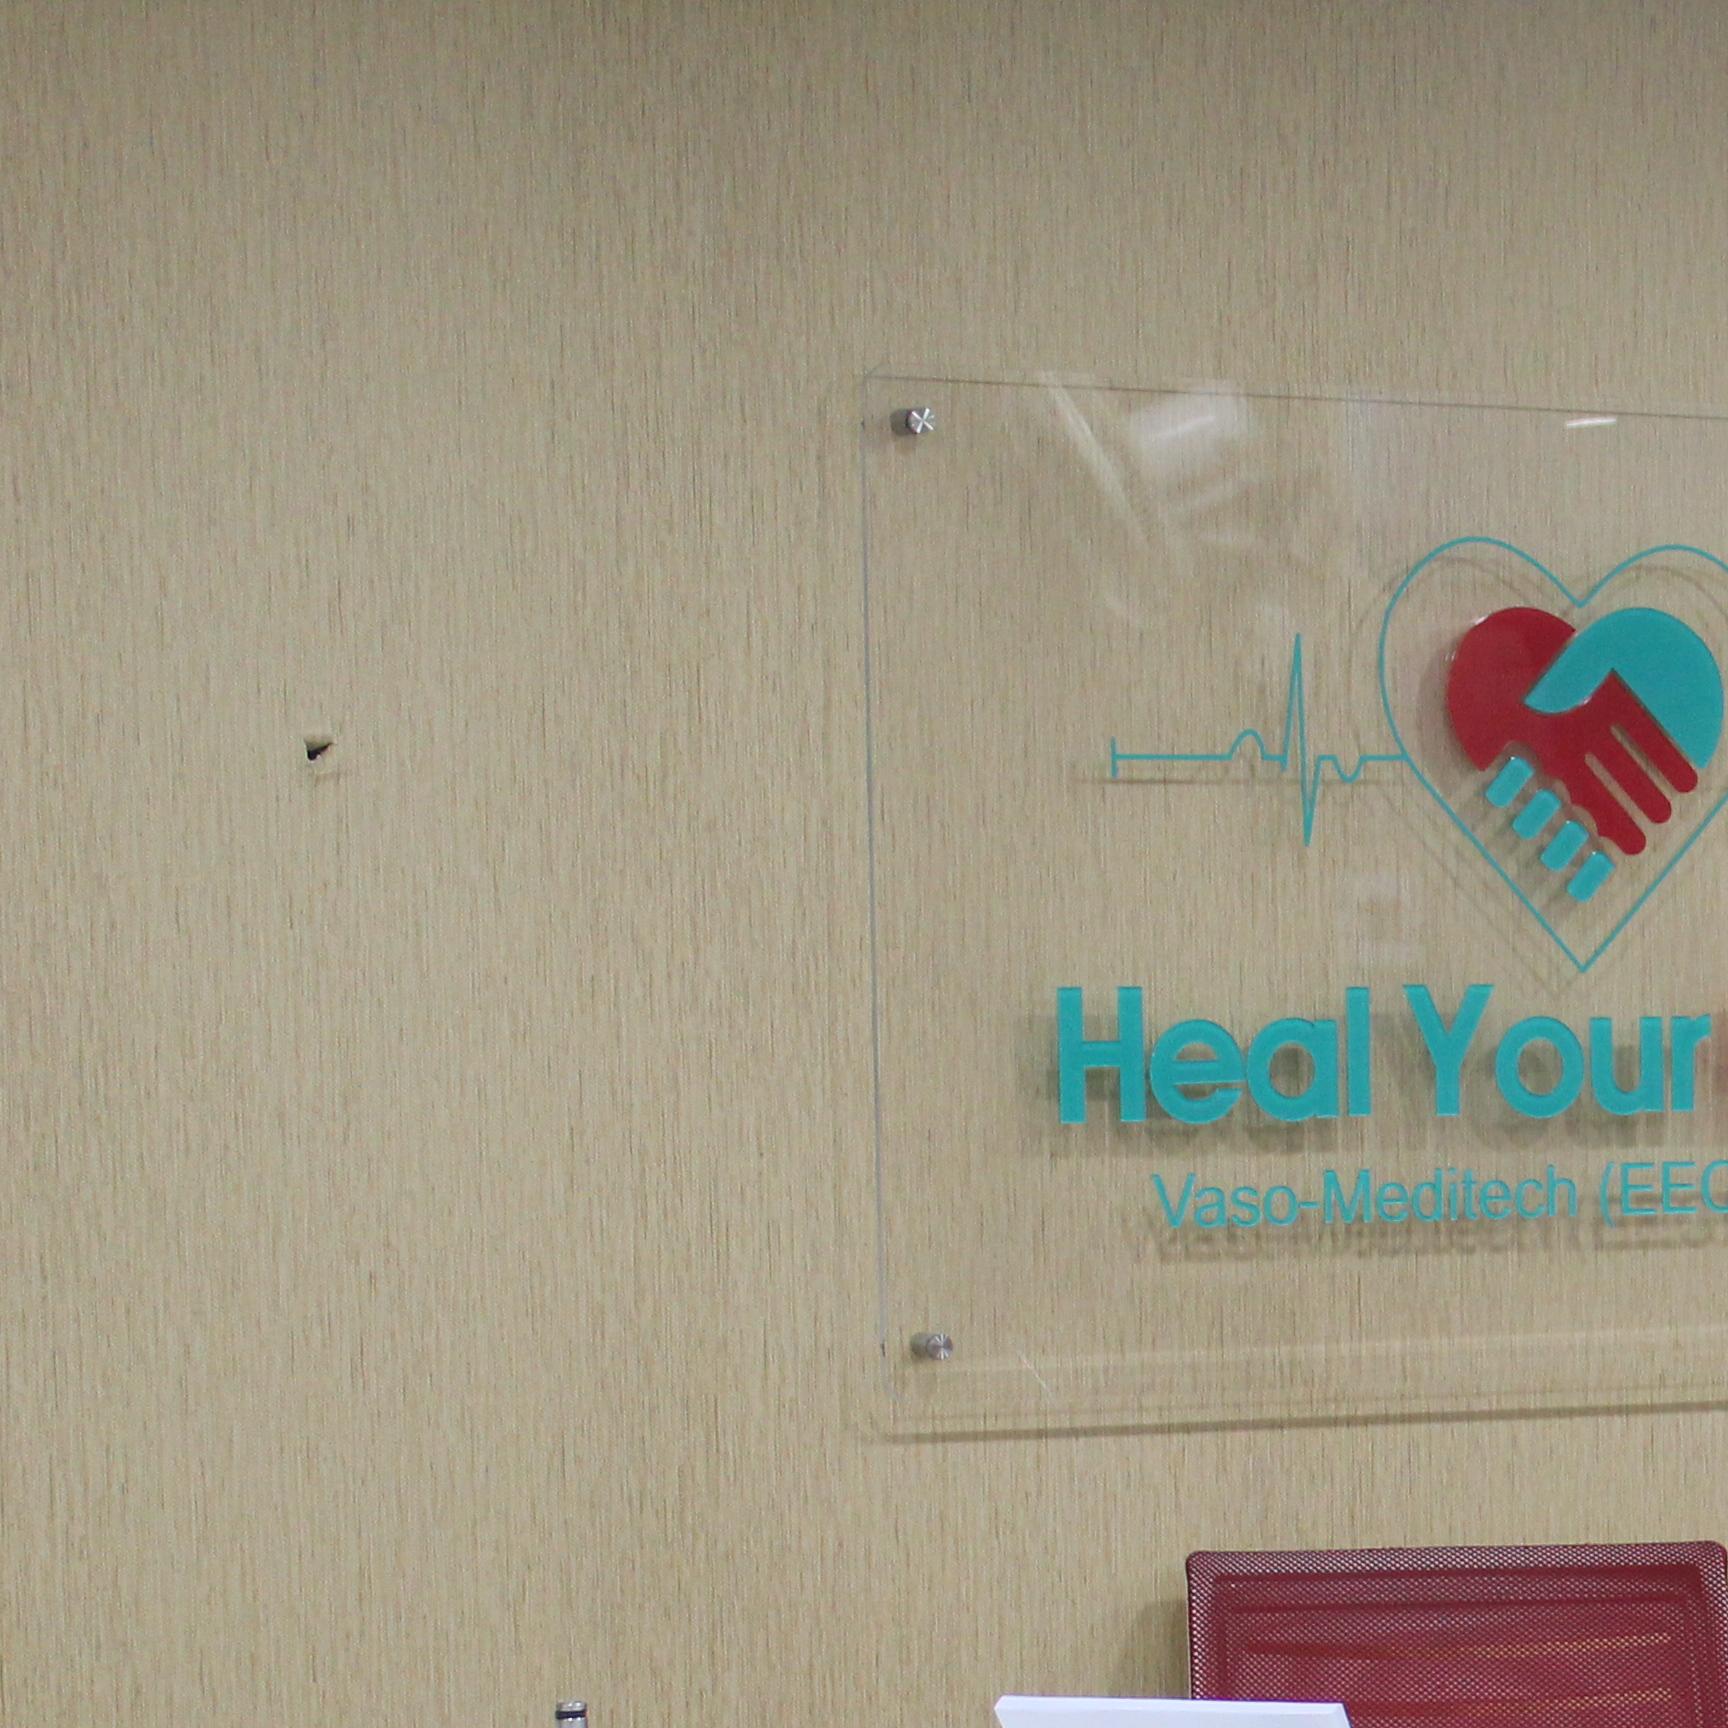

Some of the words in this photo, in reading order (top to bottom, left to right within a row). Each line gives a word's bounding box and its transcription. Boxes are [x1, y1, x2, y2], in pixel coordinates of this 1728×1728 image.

[1055, 985, 1374, 1125] Heal
[1402, 983, 1713, 1120] Your
[1152, 1164, 1578, 1231] Vaso-Meditech
